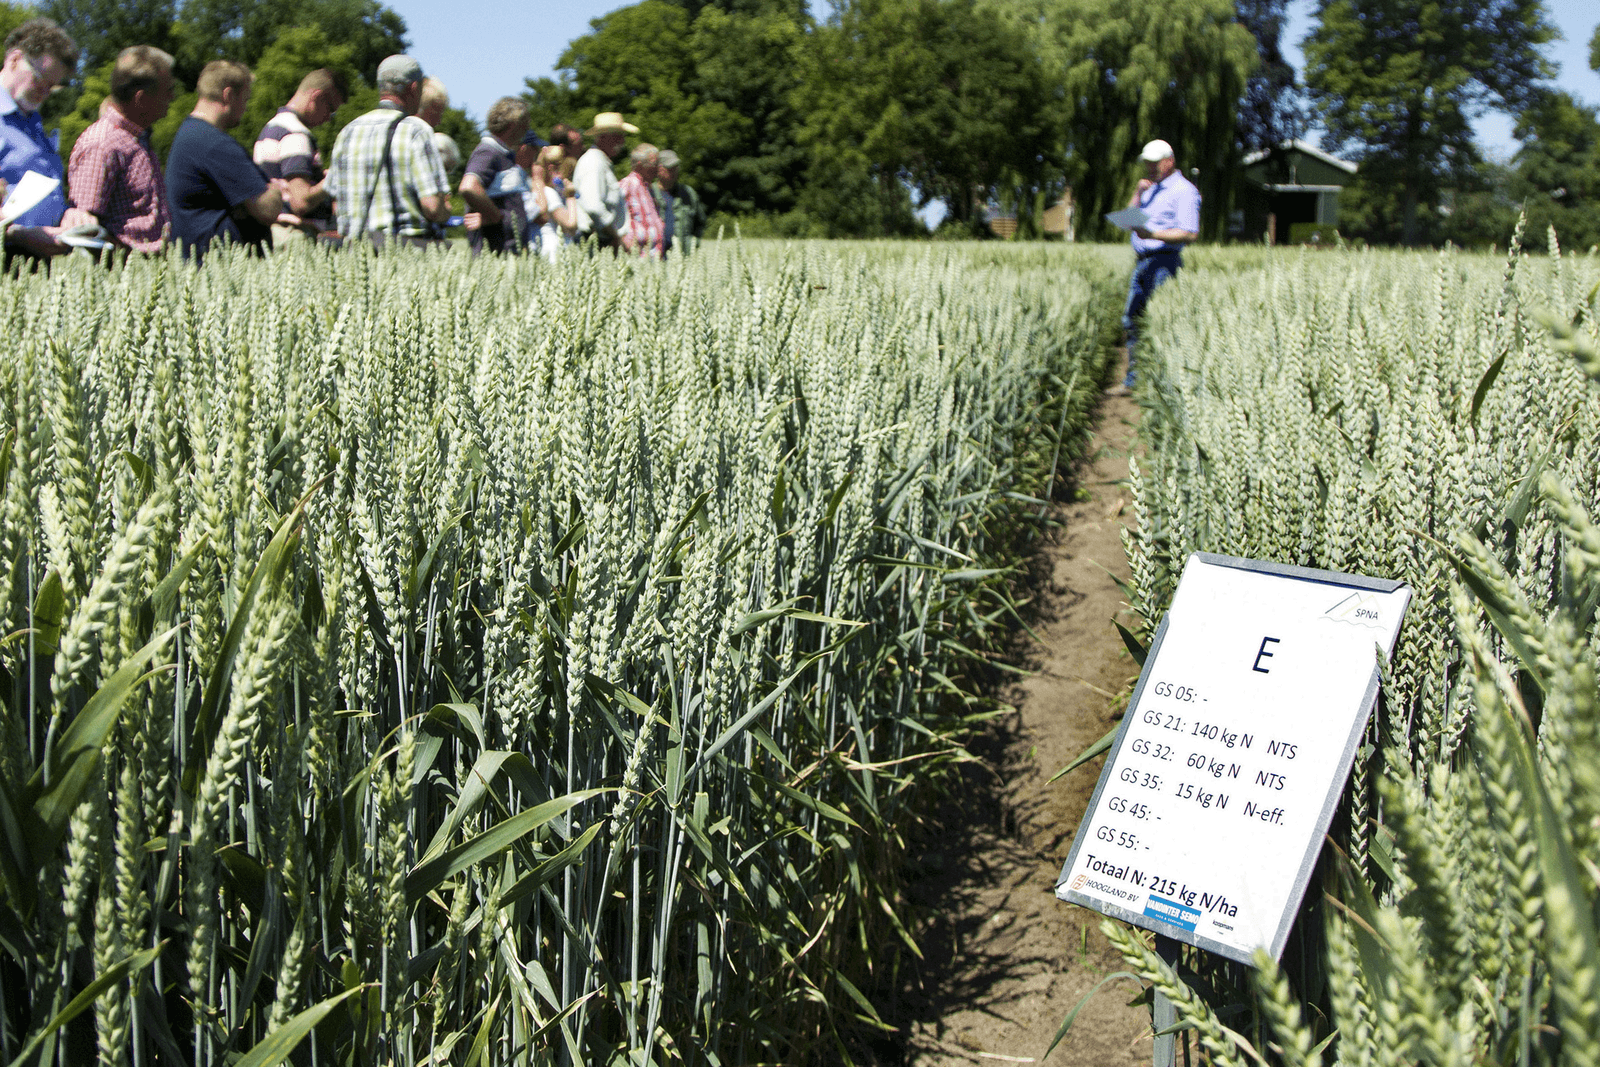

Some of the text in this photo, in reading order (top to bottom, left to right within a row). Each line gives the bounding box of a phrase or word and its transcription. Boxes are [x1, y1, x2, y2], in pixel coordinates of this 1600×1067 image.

[1355, 608, 1378, 620] SPNA
[1252, 637, 1281, 674] E
[1154, 682, 1174, 698] GS
[1176, 686, 1198, 703] 05:
[1143, 710, 1298, 760] GS 21: 140 kg N NTS
[1132, 739, 1287, 791] GS 32: 60 kg N NTS
[1109, 797, 1128, 813] GS
[1129, 803, 1152, 821] 45:
[1120, 768, 1285, 826] GS 35: 15 kg N N-eff.
[1097, 826, 1117, 842] GS
[1117, 832, 1140, 850] 55:
[1085, 854, 1238, 918] Totaal N: 215 kg N/ha
[1086, 879, 1139, 902] HOOGLAND BV
